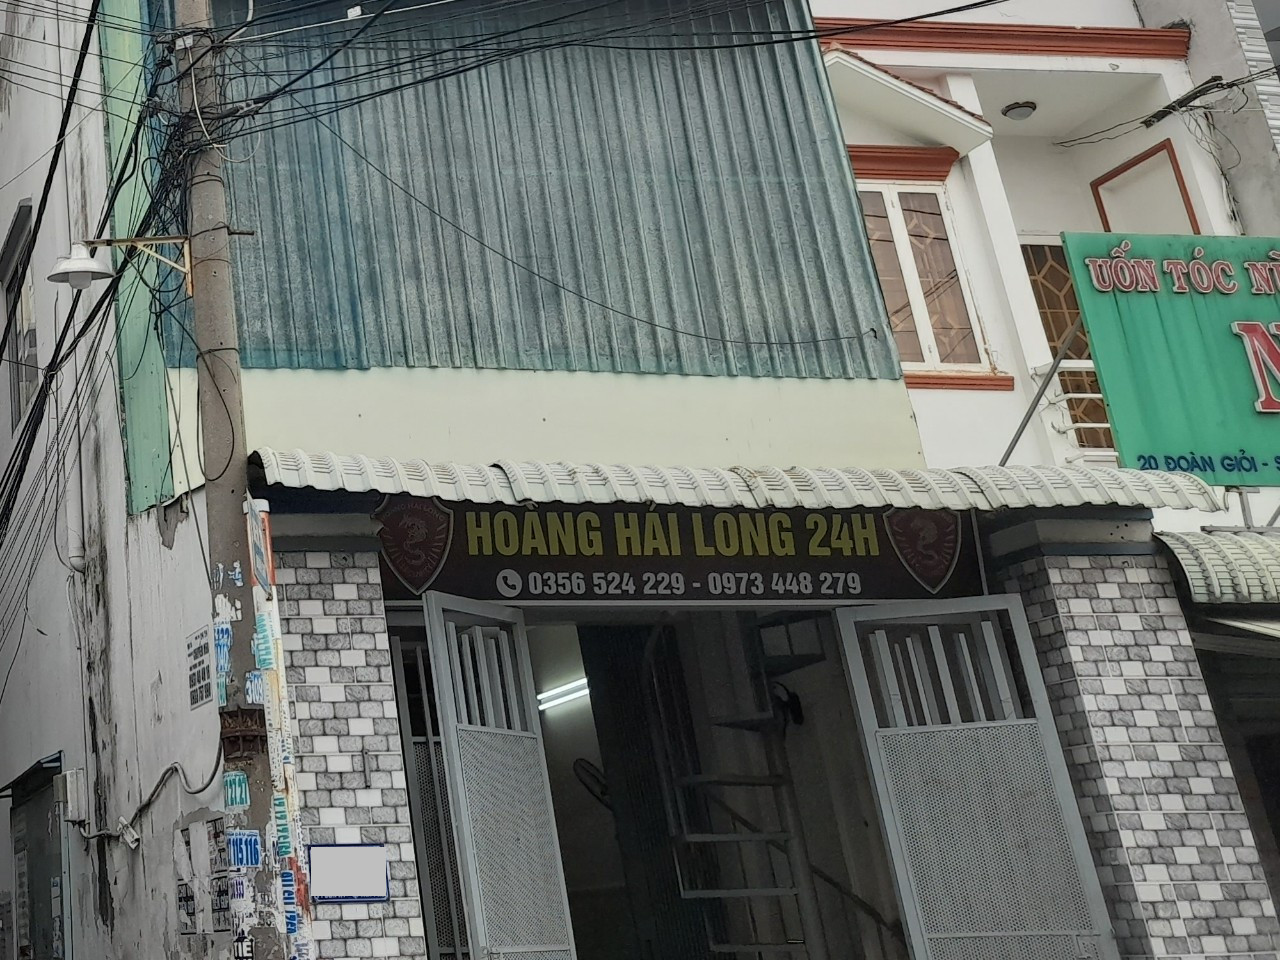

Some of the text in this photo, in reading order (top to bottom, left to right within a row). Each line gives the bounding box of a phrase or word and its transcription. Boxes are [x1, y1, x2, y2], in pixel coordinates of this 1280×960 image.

[1085, 239, 1161, 293] UỐN
[1163, 246, 1238, 295] TÓC
[1137, 454, 1159, 470] 20
[1163, 451, 1216, 473] ĐOÀN
[1220, 448, 1258, 473] GIỎI
[691, 512, 796, 557] LONG
[805, 512, 880, 557] 24H
[527, 571, 586, 595] 0356
[592, 572, 636, 595] 524
[642, 571, 685, 595] 229
[707, 572, 764, 595] 0973
[771, 572, 813, 595] 448
[819, 572, 862, 595] 279
